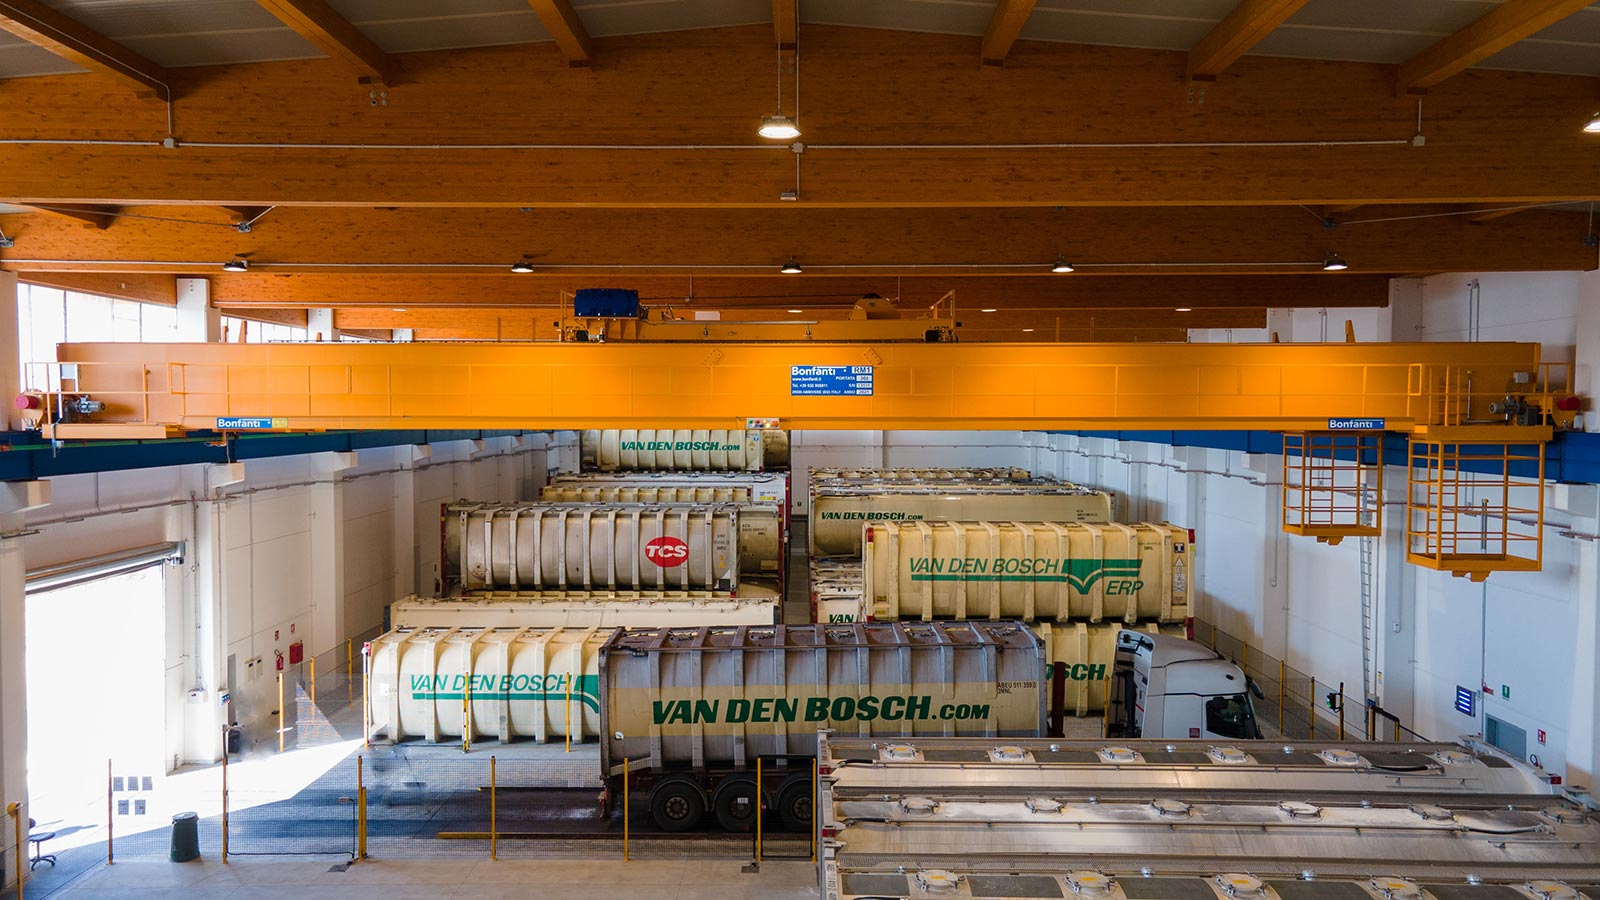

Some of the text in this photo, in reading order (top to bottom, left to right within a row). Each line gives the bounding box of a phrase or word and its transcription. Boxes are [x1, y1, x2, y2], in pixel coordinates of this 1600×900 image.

[792, 366, 836, 376] Bonfanti
[854, 366, 871, 374] RM1
[218, 418, 261, 428] Bonfanti
[1329, 419, 1373, 429] Bonfanti
[621, 441, 646, 451] VAN
[647, 441, 674, 451] DEN
[821, 511, 842, 520] VAN
[843, 511, 866, 520] DEN
[646, 545, 688, 558] TCS
[909, 557, 1059, 574] VAN DEN BOSCH
[1105, 580, 1144, 595] ERP
[829, 614, 854, 623] VAN
[410, 674, 572, 692] VAN DEN BOSCH
[652, 699, 720, 725] VAN
[725, 698, 799, 723] DEN
